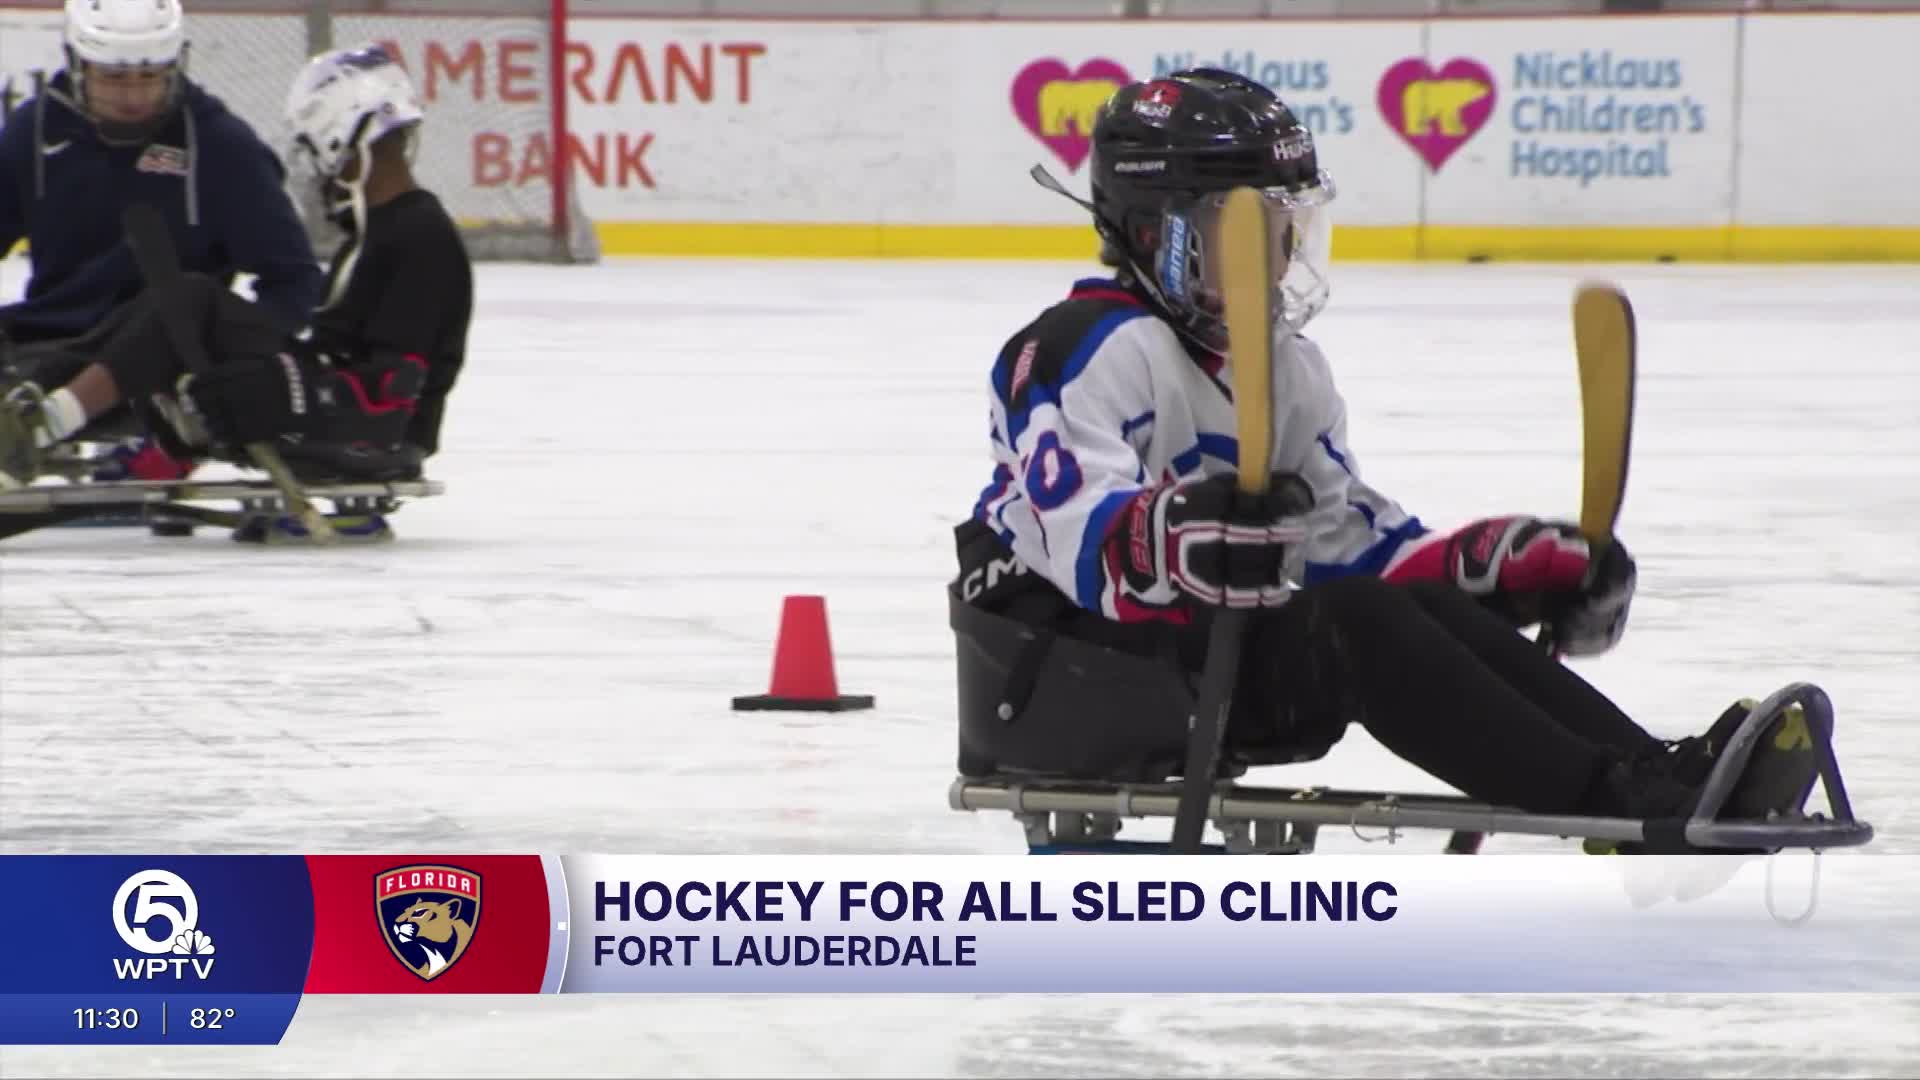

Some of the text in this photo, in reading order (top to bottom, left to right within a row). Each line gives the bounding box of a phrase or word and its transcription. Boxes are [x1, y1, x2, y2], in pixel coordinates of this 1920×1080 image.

[1154, 48, 1329, 90] Nklaus
[1512, 48, 1683, 89] Nicklaus
[1511, 95, 1706, 133] Children's
[472, 132, 657, 188] BANK
[1511, 139, 1671, 188] Hospital
